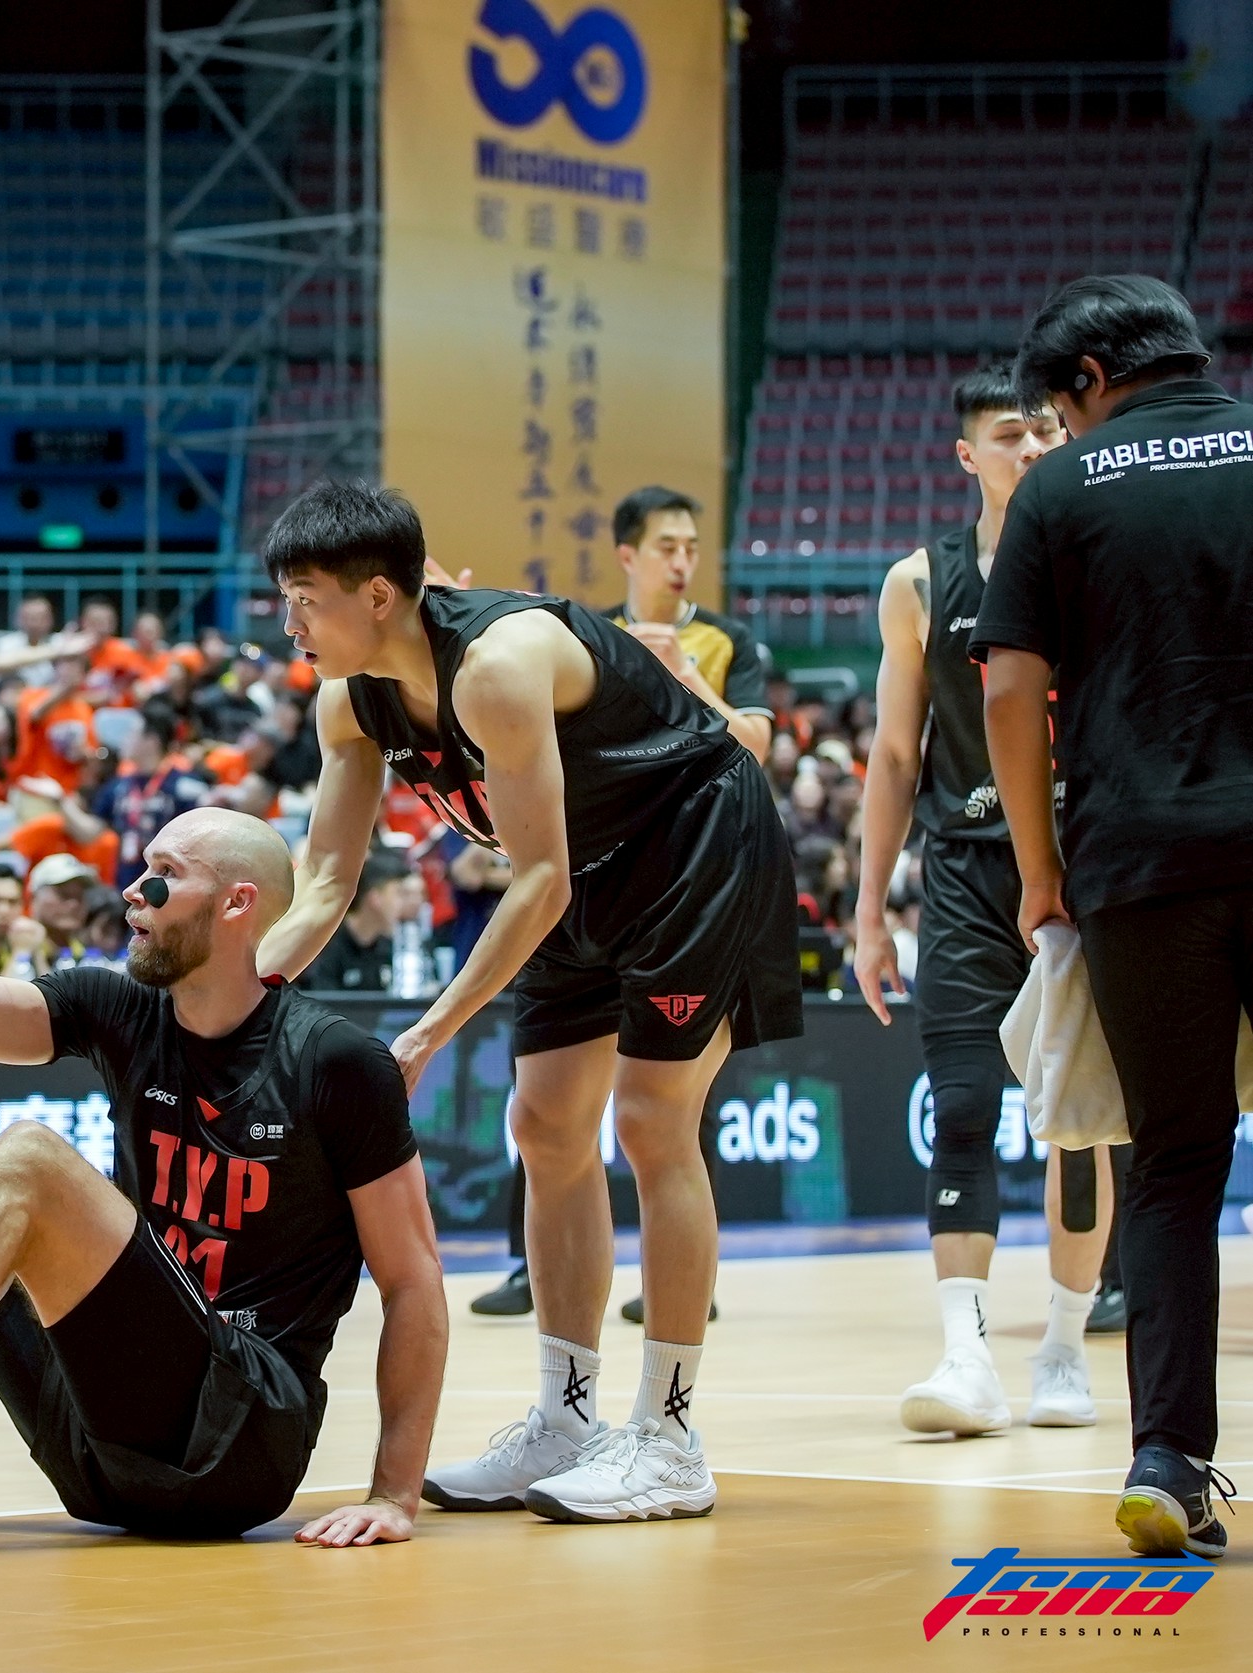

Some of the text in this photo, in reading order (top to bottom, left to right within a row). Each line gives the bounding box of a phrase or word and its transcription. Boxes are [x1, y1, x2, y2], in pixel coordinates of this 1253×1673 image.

[1079, 430, 1253, 475] TABLE OFFICI
[1150, 461, 1208, 472] PROFESSIONAL
[600, 739, 701, 758] NEVER GIVE UP
[150, 1130, 269, 1229] T.Y.P
